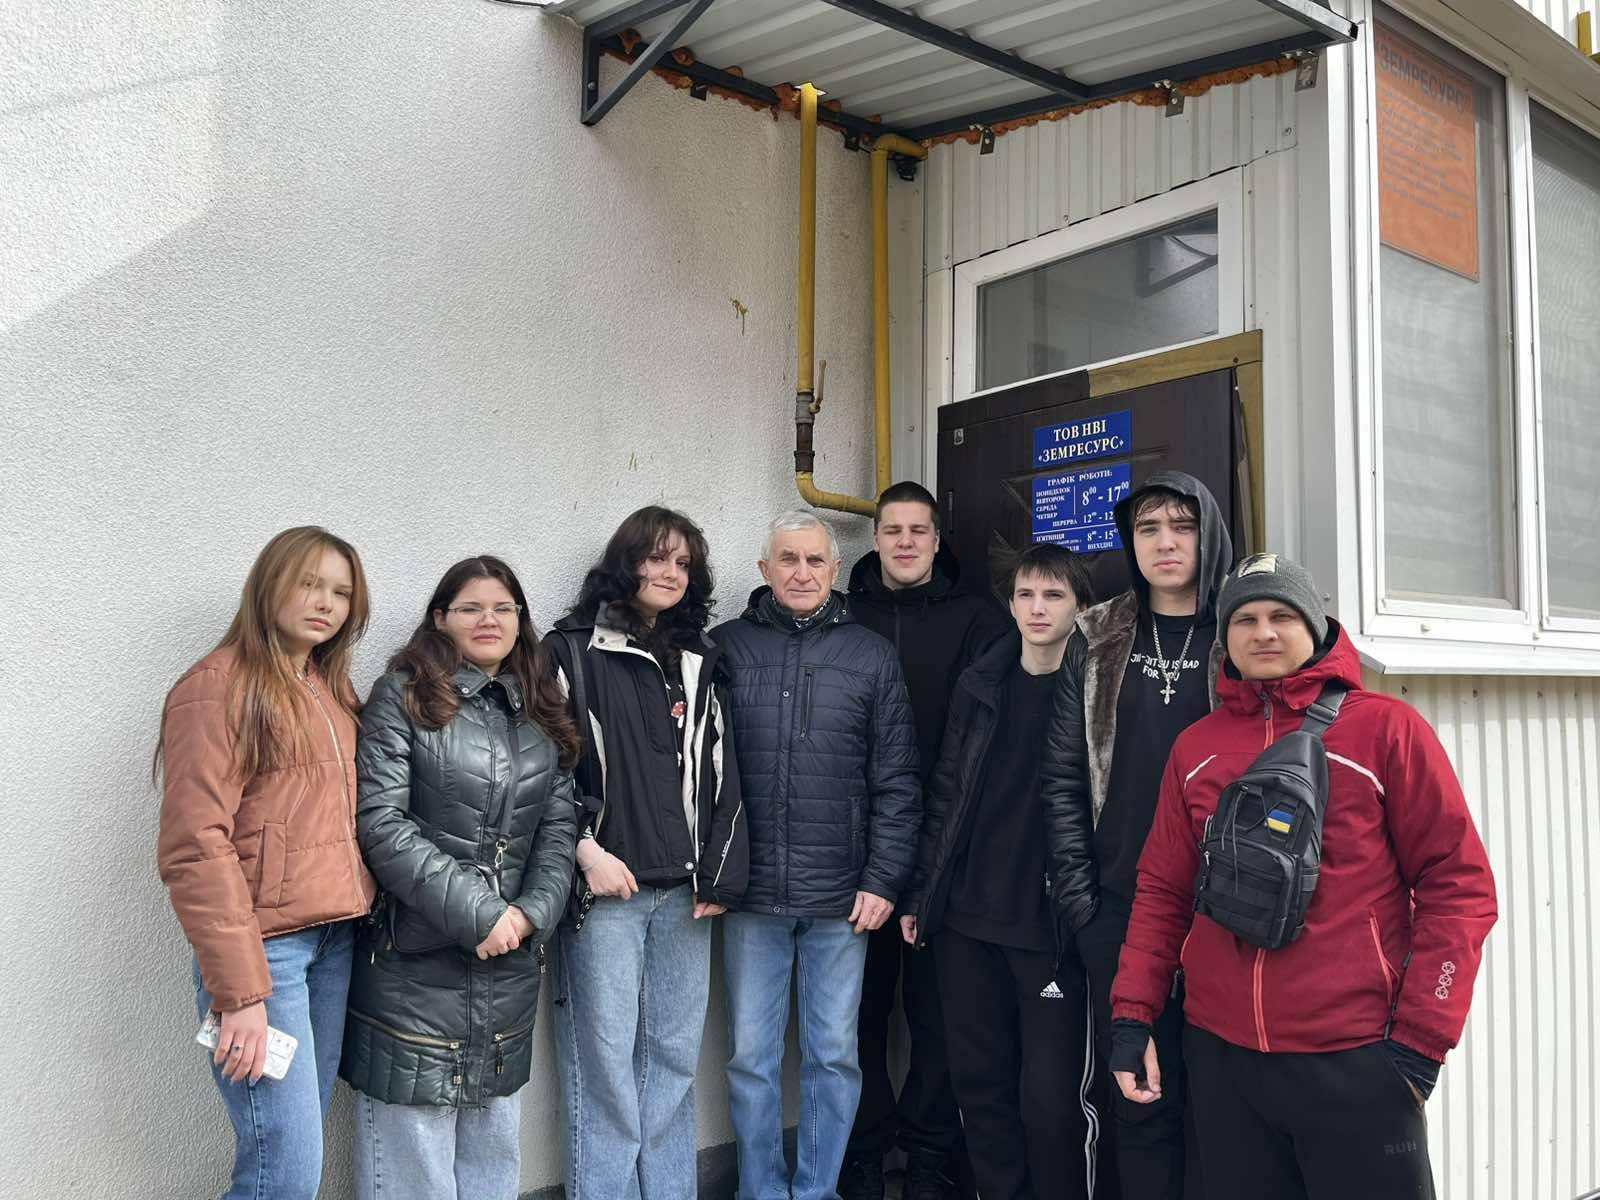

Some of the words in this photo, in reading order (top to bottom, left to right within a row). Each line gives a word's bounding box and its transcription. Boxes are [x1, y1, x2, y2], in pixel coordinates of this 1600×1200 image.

[1053, 425, 1079, 442] ТОВ
[1082, 419, 1106, 437] НВІ
[1038, 435, 1124, 463] «ЗЕМРЕСУРС»
[1047, 475, 1075, 487] ГРАФІК
[1079, 469, 1113, 482] РОБОТИ:
[1142, 665, 1160, 679] FOR
[1171, 660, 1180, 669] IS
[1182, 660, 1200, 669] BAD
